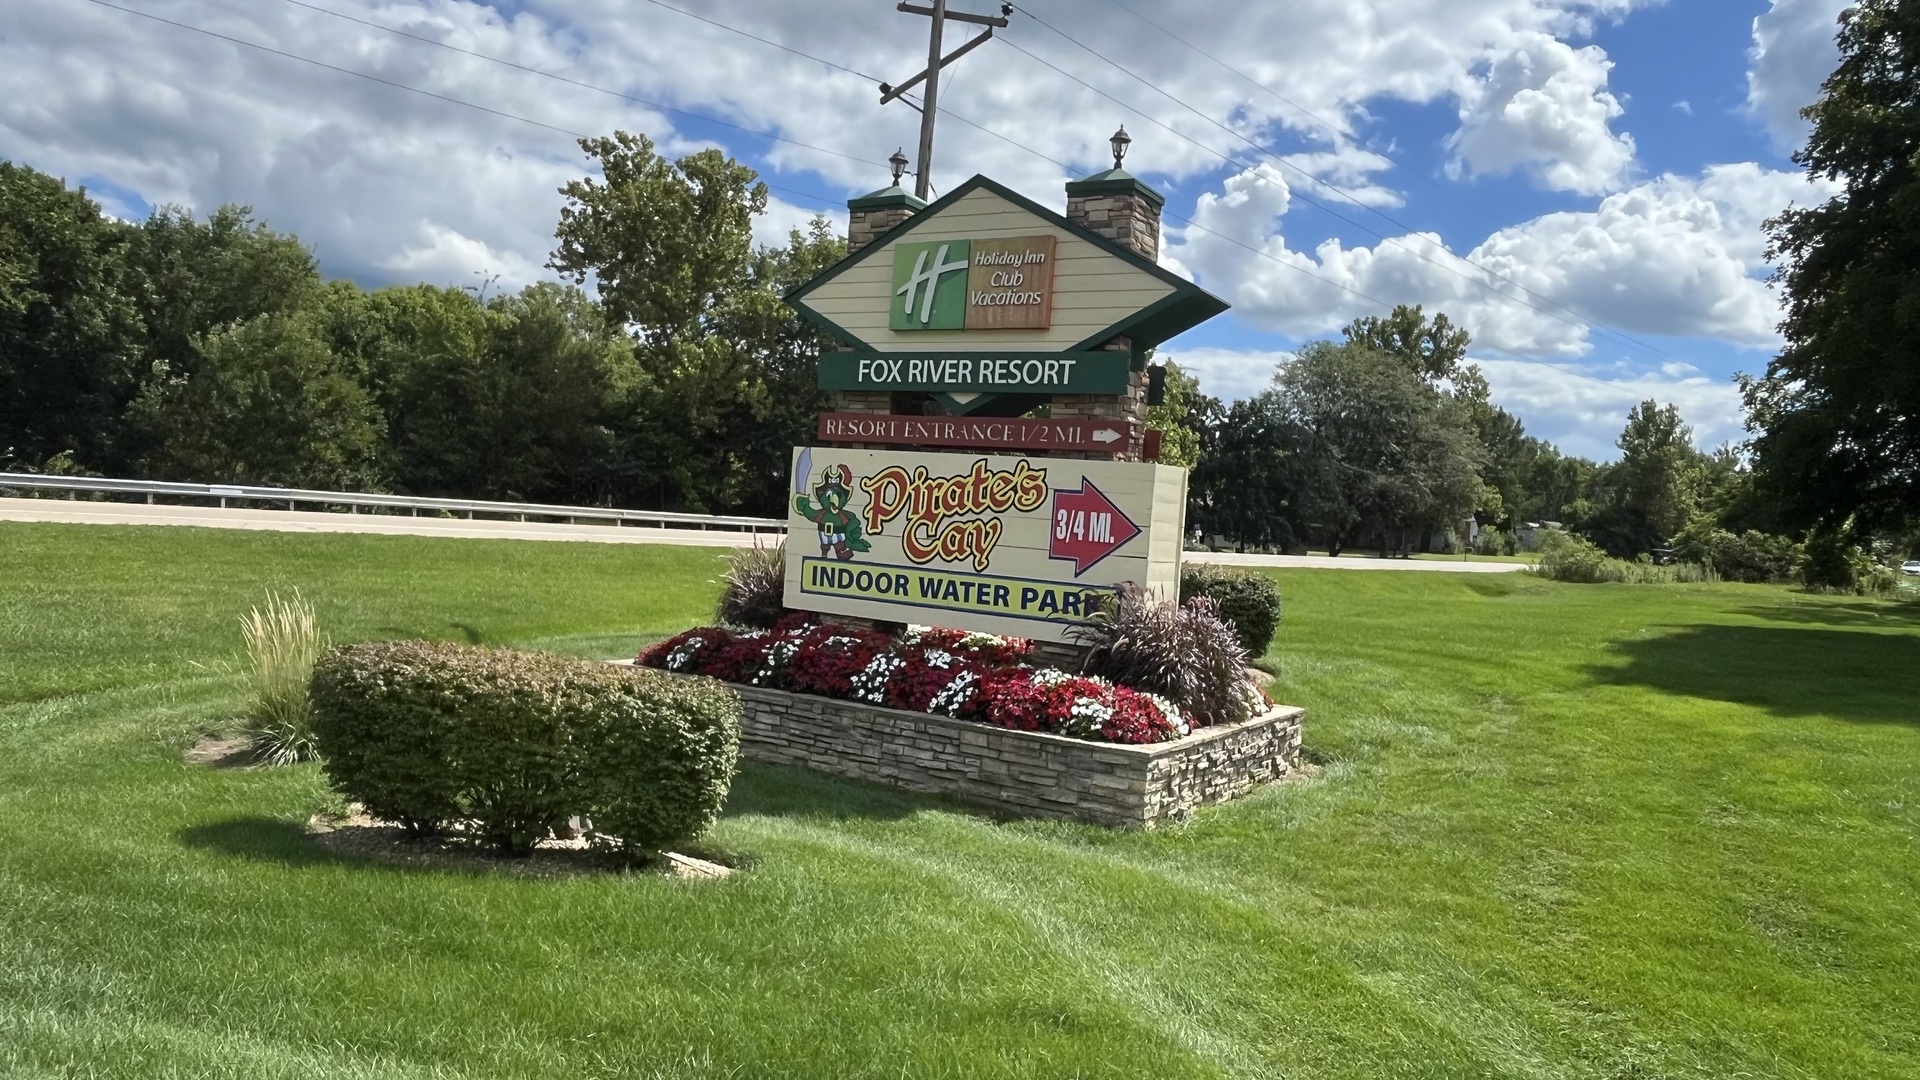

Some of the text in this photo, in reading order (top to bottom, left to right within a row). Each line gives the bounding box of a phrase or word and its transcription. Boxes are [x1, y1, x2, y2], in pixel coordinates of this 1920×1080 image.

[975, 249, 1045, 268] Holiday Inn
[991, 271, 1023, 287] Club
[971, 289, 1041, 306] Vacations
[858, 359, 1076, 385] FOX RIVER RESORT
[826, 419, 899, 437] RESORT
[904, 421, 1014, 442] ENTRANCE
[1021, 424, 1048, 442] 1/2
[860, 458, 1048, 537] Pirate's
[1056, 508, 1115, 544] 3/4 MI.
[902, 516, 1003, 573] Cay
[811, 565, 910, 597] INDOOR
[918, 576, 1011, 608] WATER
